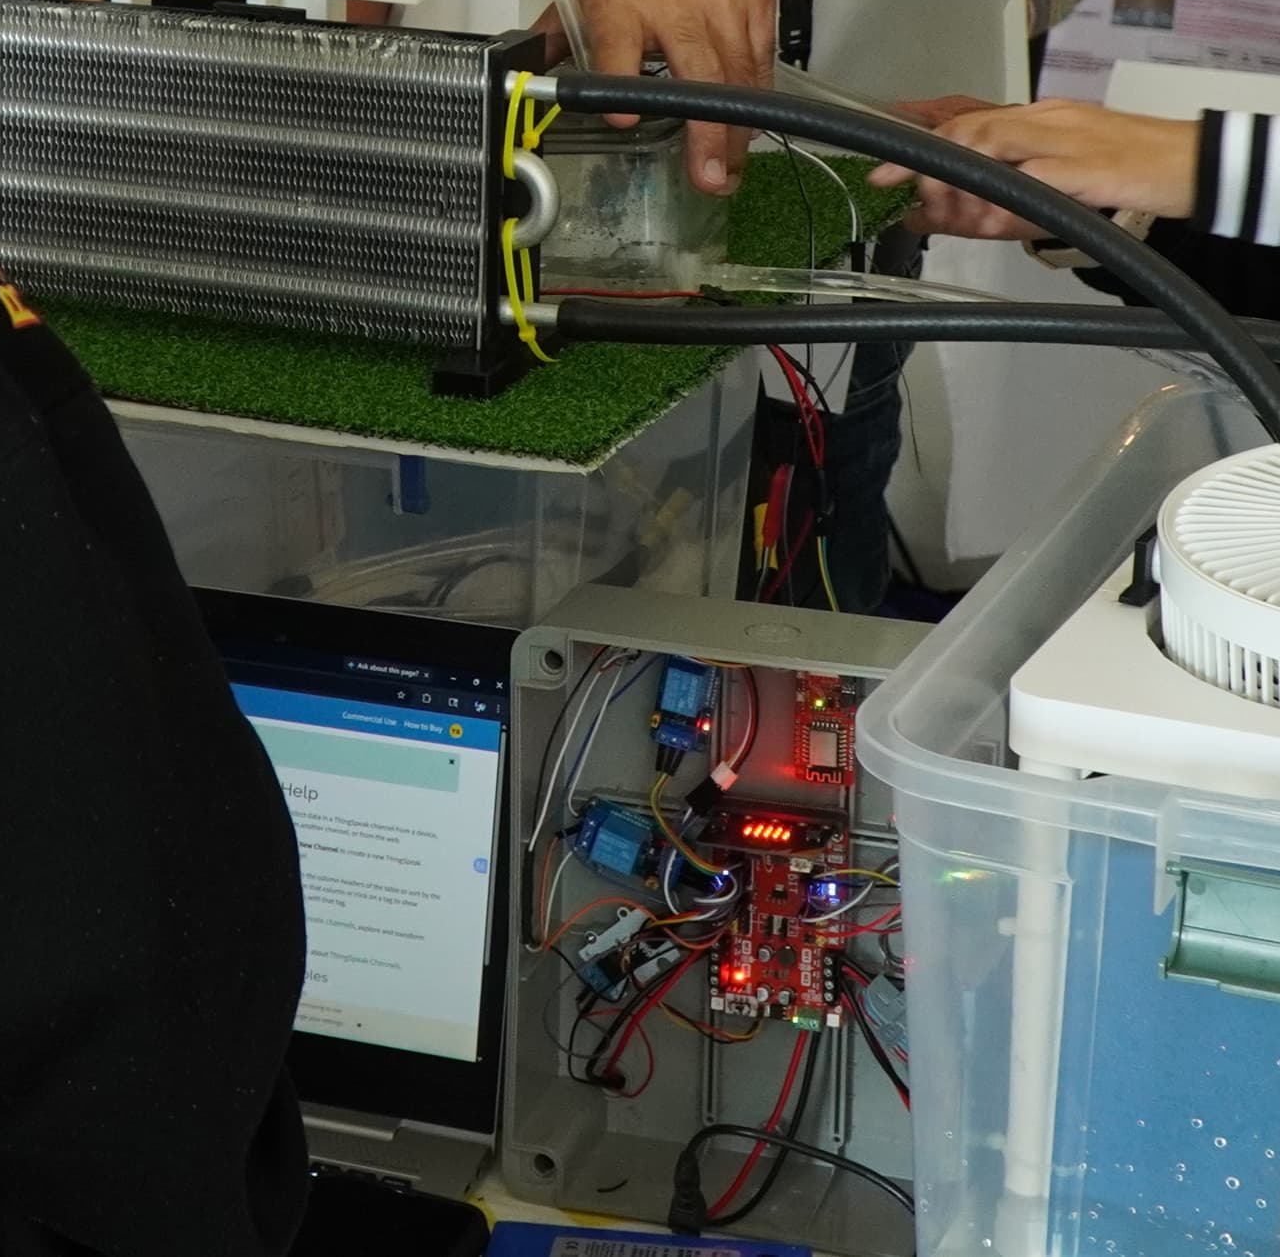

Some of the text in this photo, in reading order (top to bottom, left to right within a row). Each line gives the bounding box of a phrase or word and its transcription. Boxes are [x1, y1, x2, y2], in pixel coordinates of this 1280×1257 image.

[357, 662, 419, 677] Ask about this page?
[342, 711, 382, 724] Commercial
[384, 717, 397, 726] Use
[404, 720, 417, 730] How
[430, 724, 443, 734] Buy
[282, 782, 319, 802] Help
[314, 843, 338, 853] Channel
